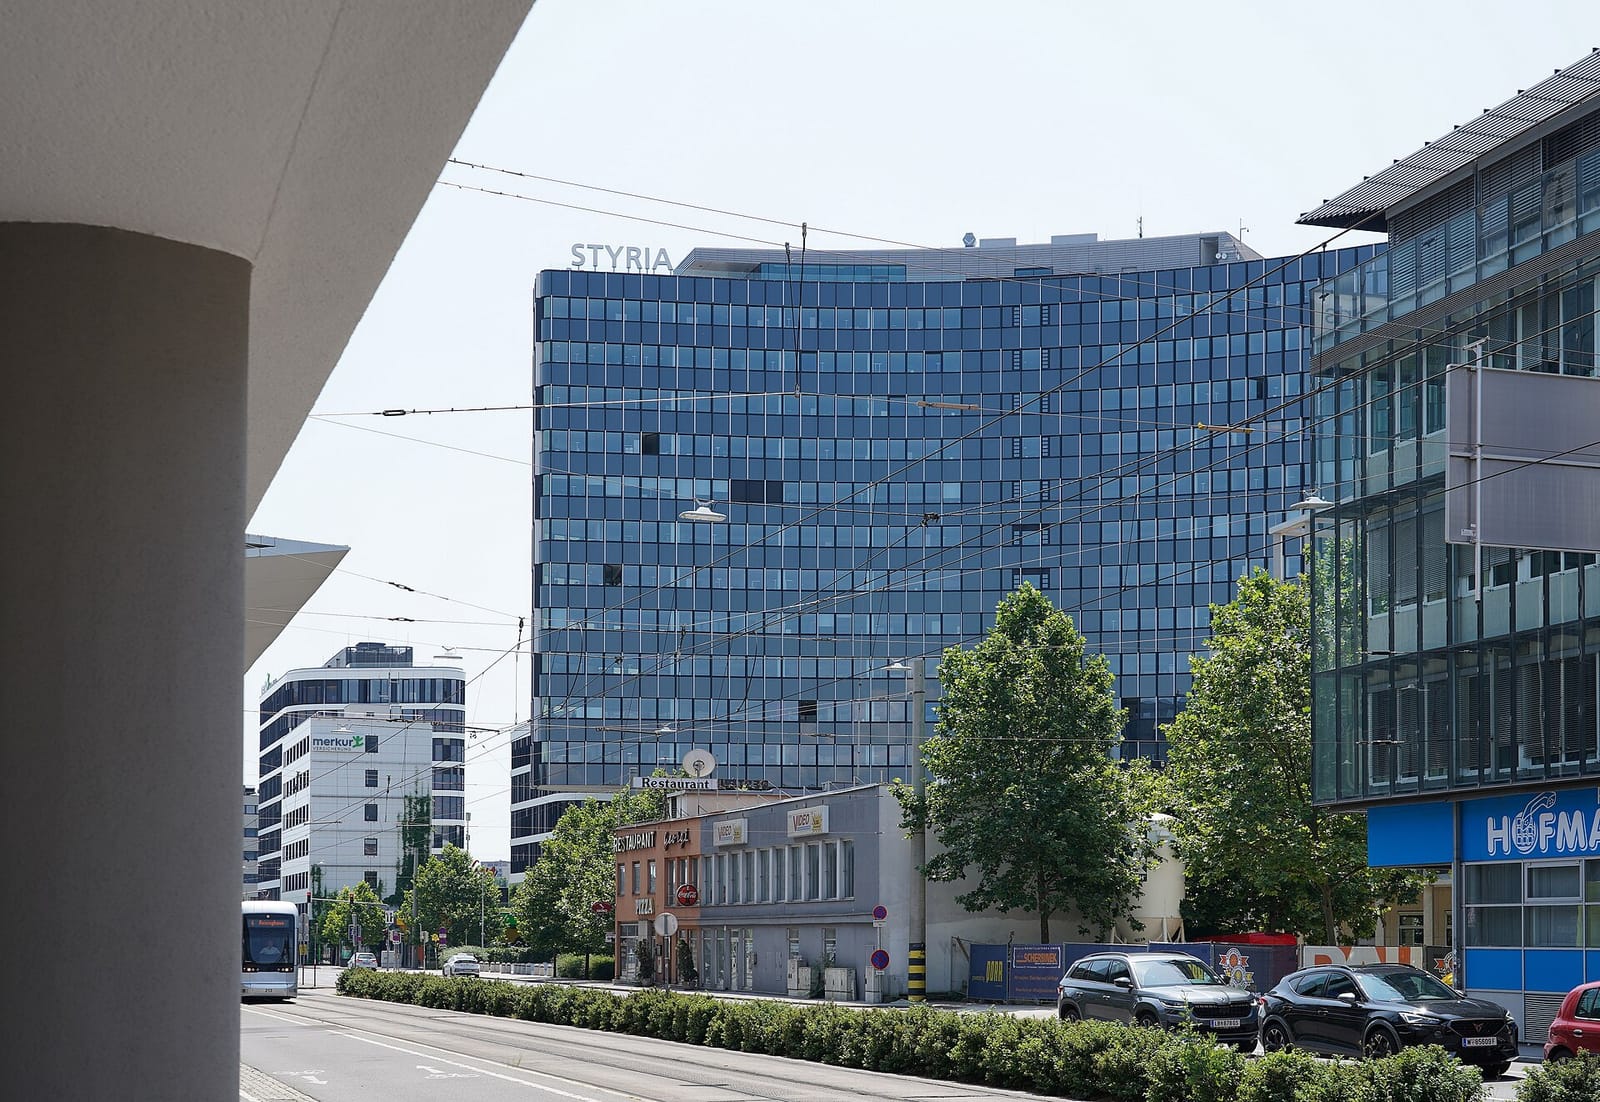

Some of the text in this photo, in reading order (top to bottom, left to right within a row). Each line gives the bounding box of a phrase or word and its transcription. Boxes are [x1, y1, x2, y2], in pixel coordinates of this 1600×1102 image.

[571, 243, 673, 270] STYRIA
[313, 738, 353, 746] merkur
[641, 778, 710, 789] Restaurant
[793, 814, 809, 831] VIDEO
[613, 831, 656, 853] RESTAURANT
[635, 898, 654, 915] PIZZA
